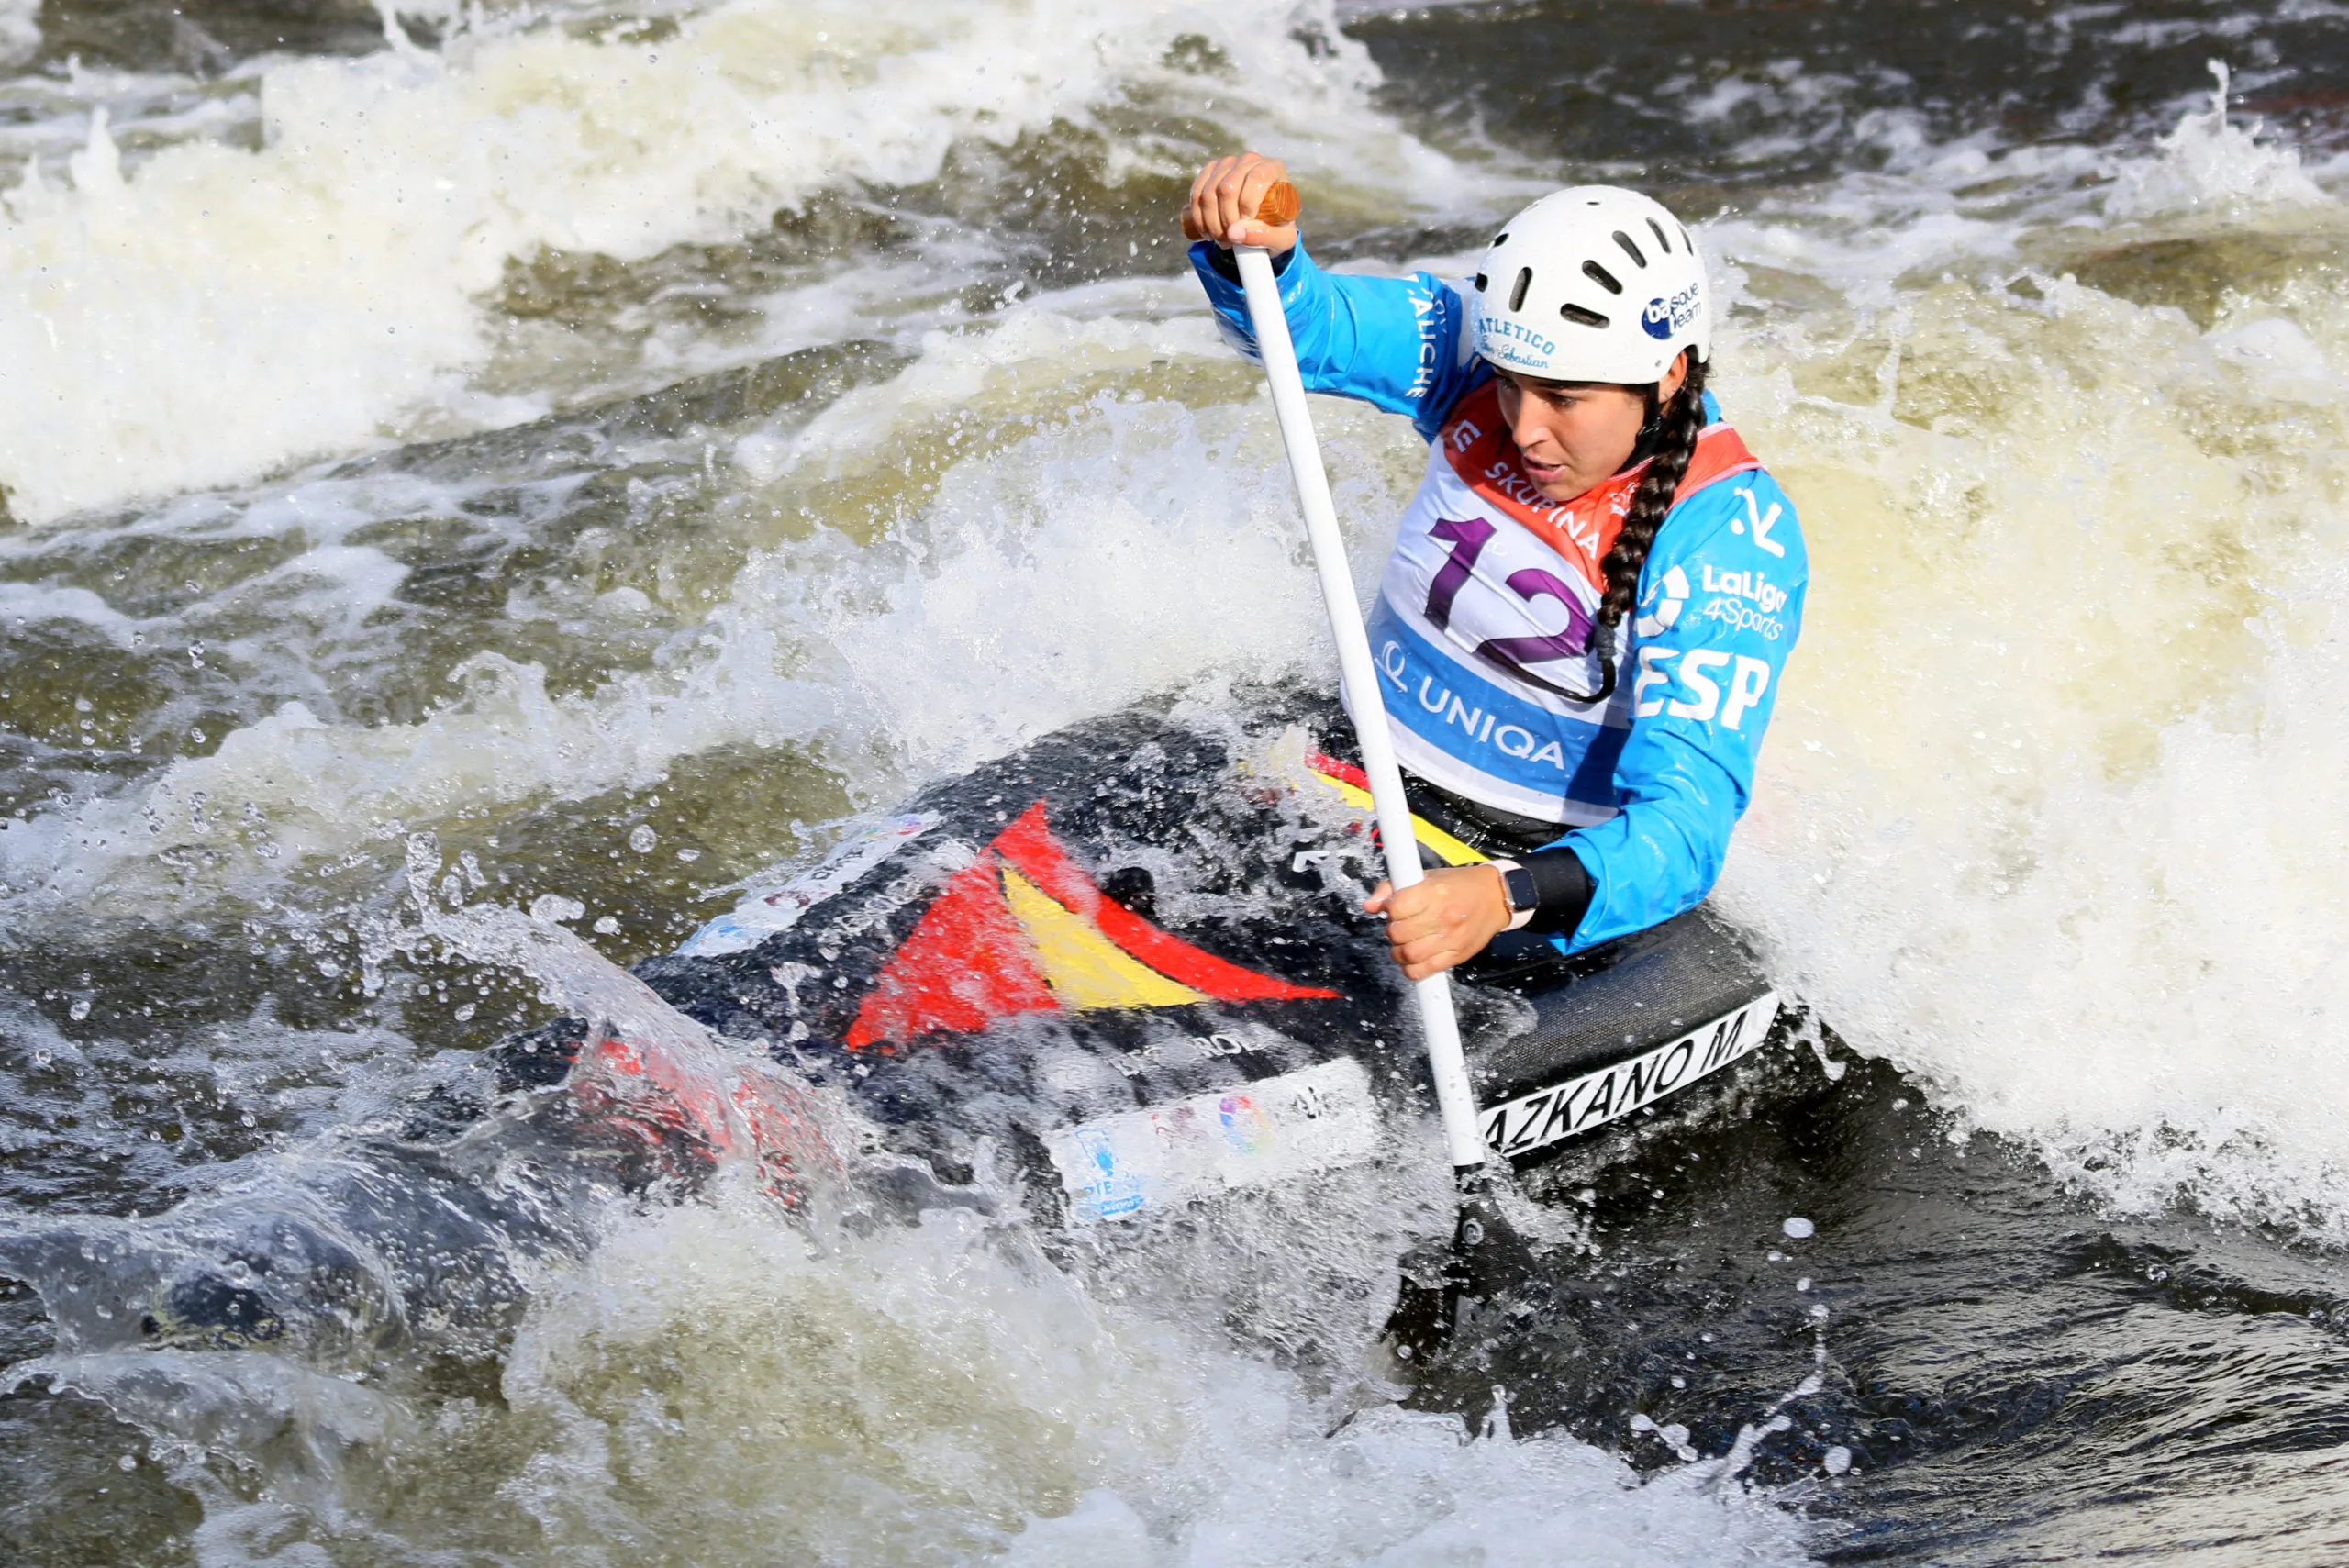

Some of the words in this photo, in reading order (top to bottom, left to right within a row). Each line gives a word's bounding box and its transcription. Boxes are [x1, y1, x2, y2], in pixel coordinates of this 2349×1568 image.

[1479, 317, 1556, 356] ATLETICO
[1497, 344, 1550, 369] Sebastian
[1484, 462, 1601, 560] SKUPINA
[1425, 517, 1595, 665] 12
[1702, 564, 1788, 613] LaLiga
[1703, 596, 1785, 640] 4Sports
[1633, 646, 1771, 731] ESP
[1419, 684, 1566, 771] UNIQA
